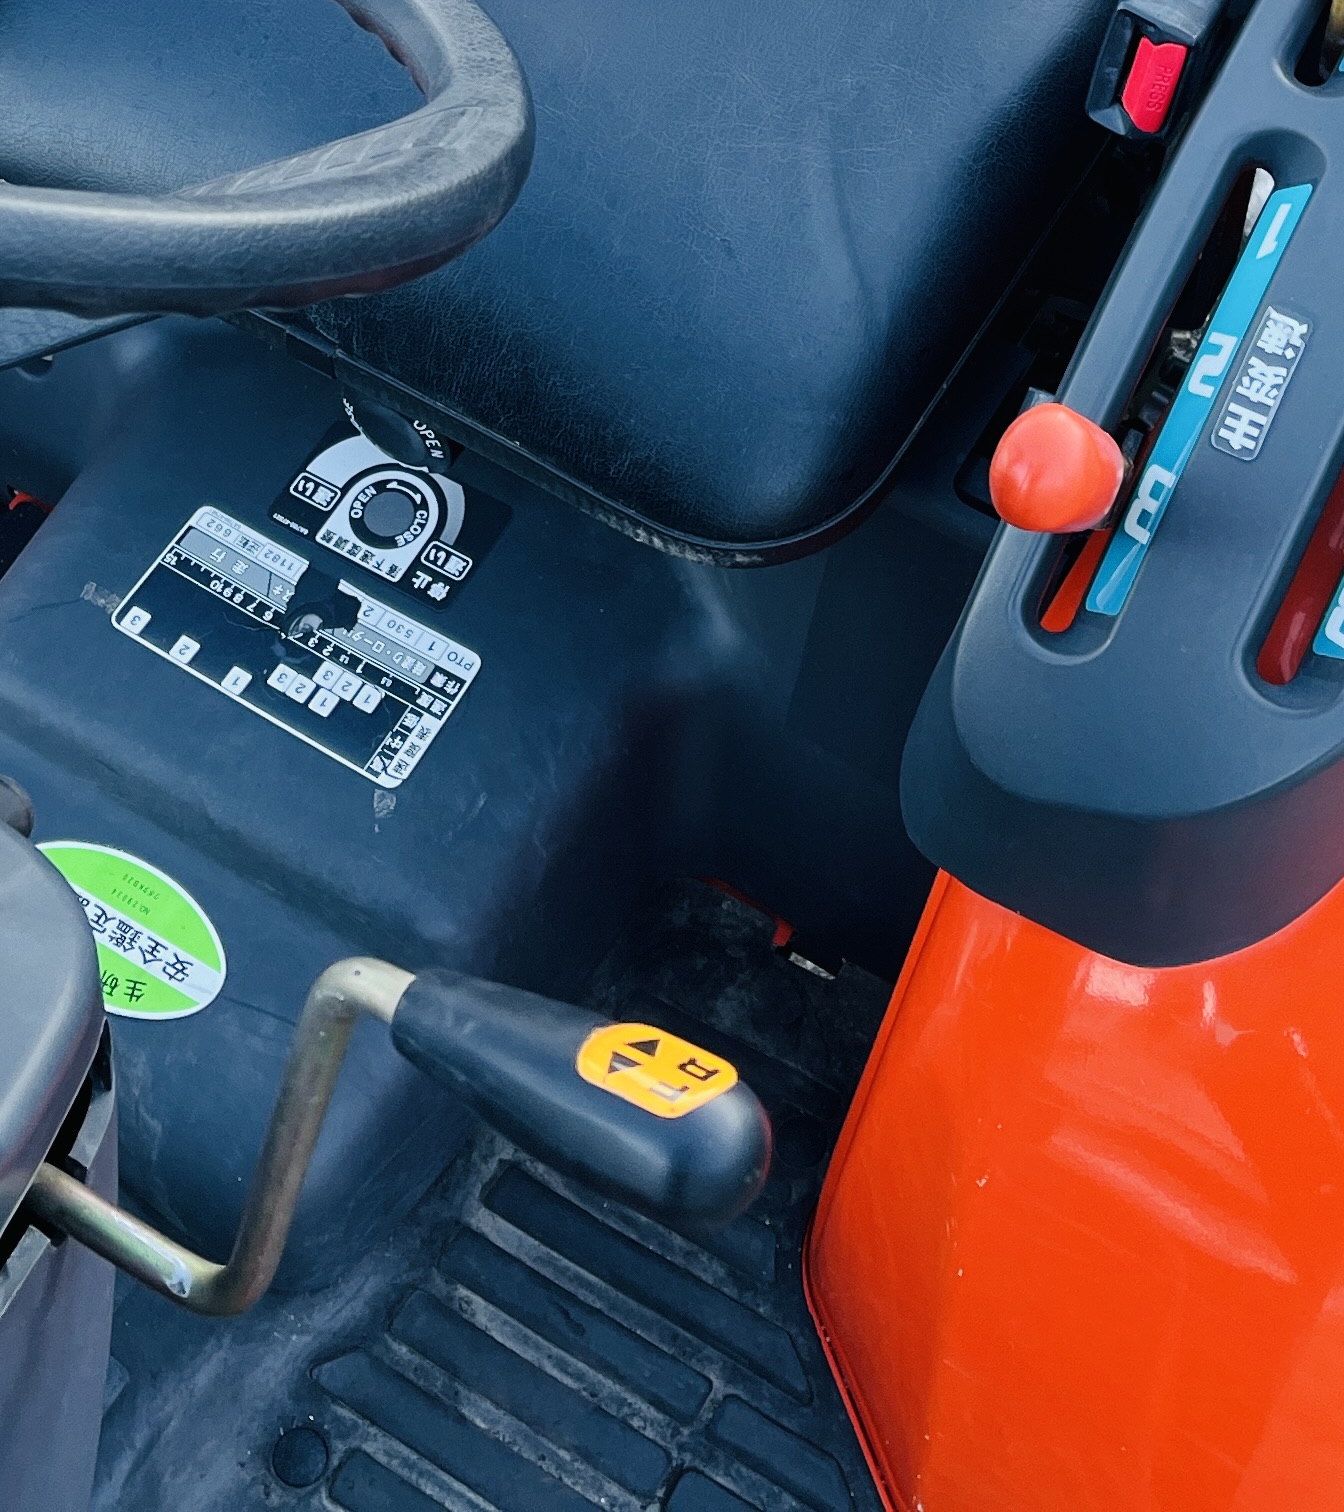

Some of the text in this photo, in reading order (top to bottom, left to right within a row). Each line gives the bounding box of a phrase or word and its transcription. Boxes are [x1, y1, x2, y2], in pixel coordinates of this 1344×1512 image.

[1146, 65, 1172, 112] PRESS
[1121, 196, 1295, 543] 3 2 1
[1215, 305, 1311, 456] 主変速
[350, 484, 378, 518] OPEN
[204, 516, 233, 538] 662
[393, 509, 429, 544] CLOSE
[208, 546, 249, 575] 走行
[262, 547, 296, 571] 1182
[320, 527, 402, 579] 落下速度調整
[409, 569, 451, 602] 停止
[385, 617, 414, 639] 530
[445, 649, 475, 671] PTO
[428, 670, 461, 696] 作業
[415, 690, 447, 716] 速度
